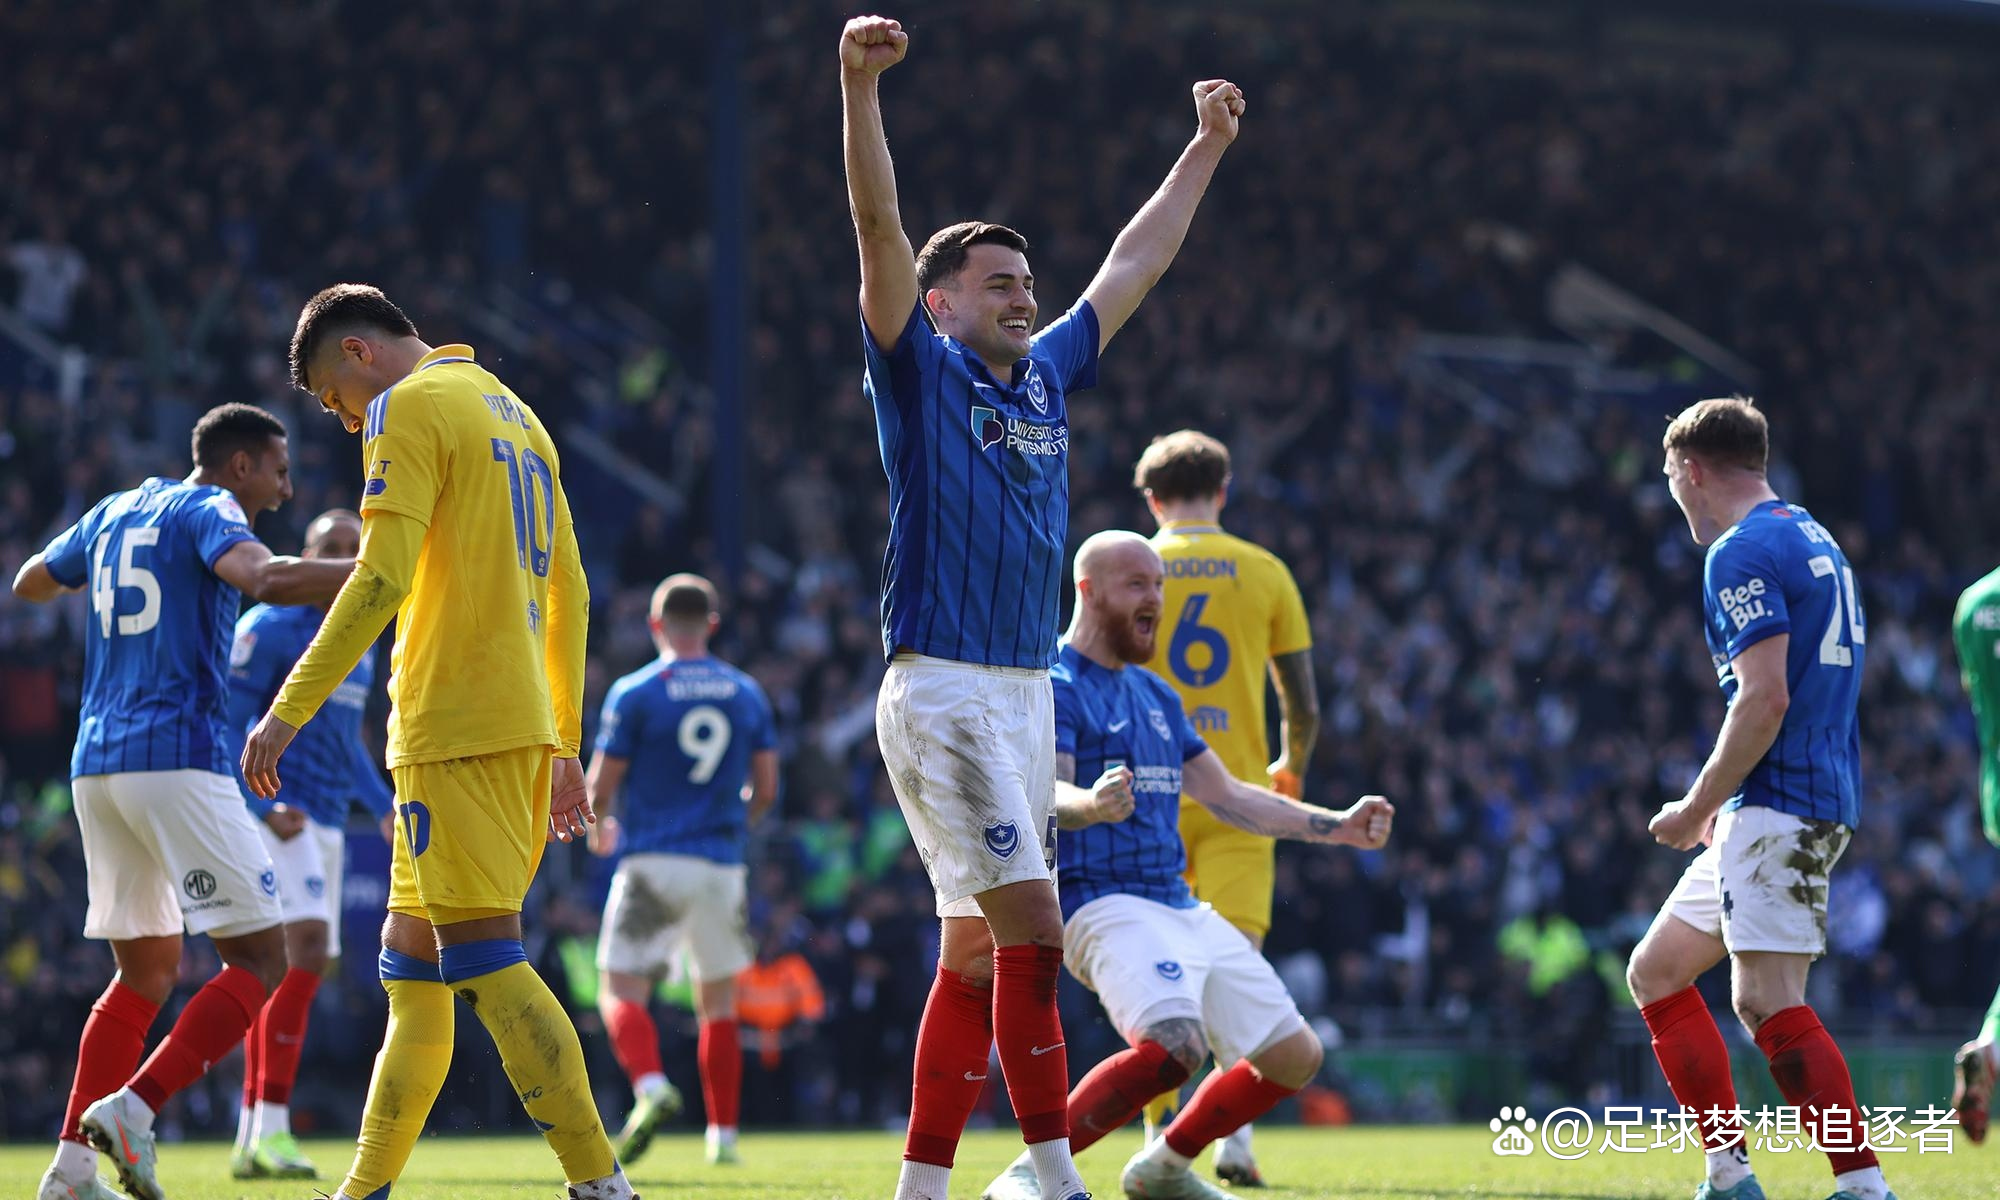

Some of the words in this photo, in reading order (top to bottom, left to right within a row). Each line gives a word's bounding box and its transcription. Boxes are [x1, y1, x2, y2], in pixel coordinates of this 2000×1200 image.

[1053, 426, 1067, 437] OF
[490, 438, 554, 577] 10
[93, 527, 162, 639] 45
[1718, 577, 1766, 613] Bee
[1729, 598, 1774, 632] Bu.
[1168, 593, 1230, 689] 6
[677, 705, 732, 784] 9
